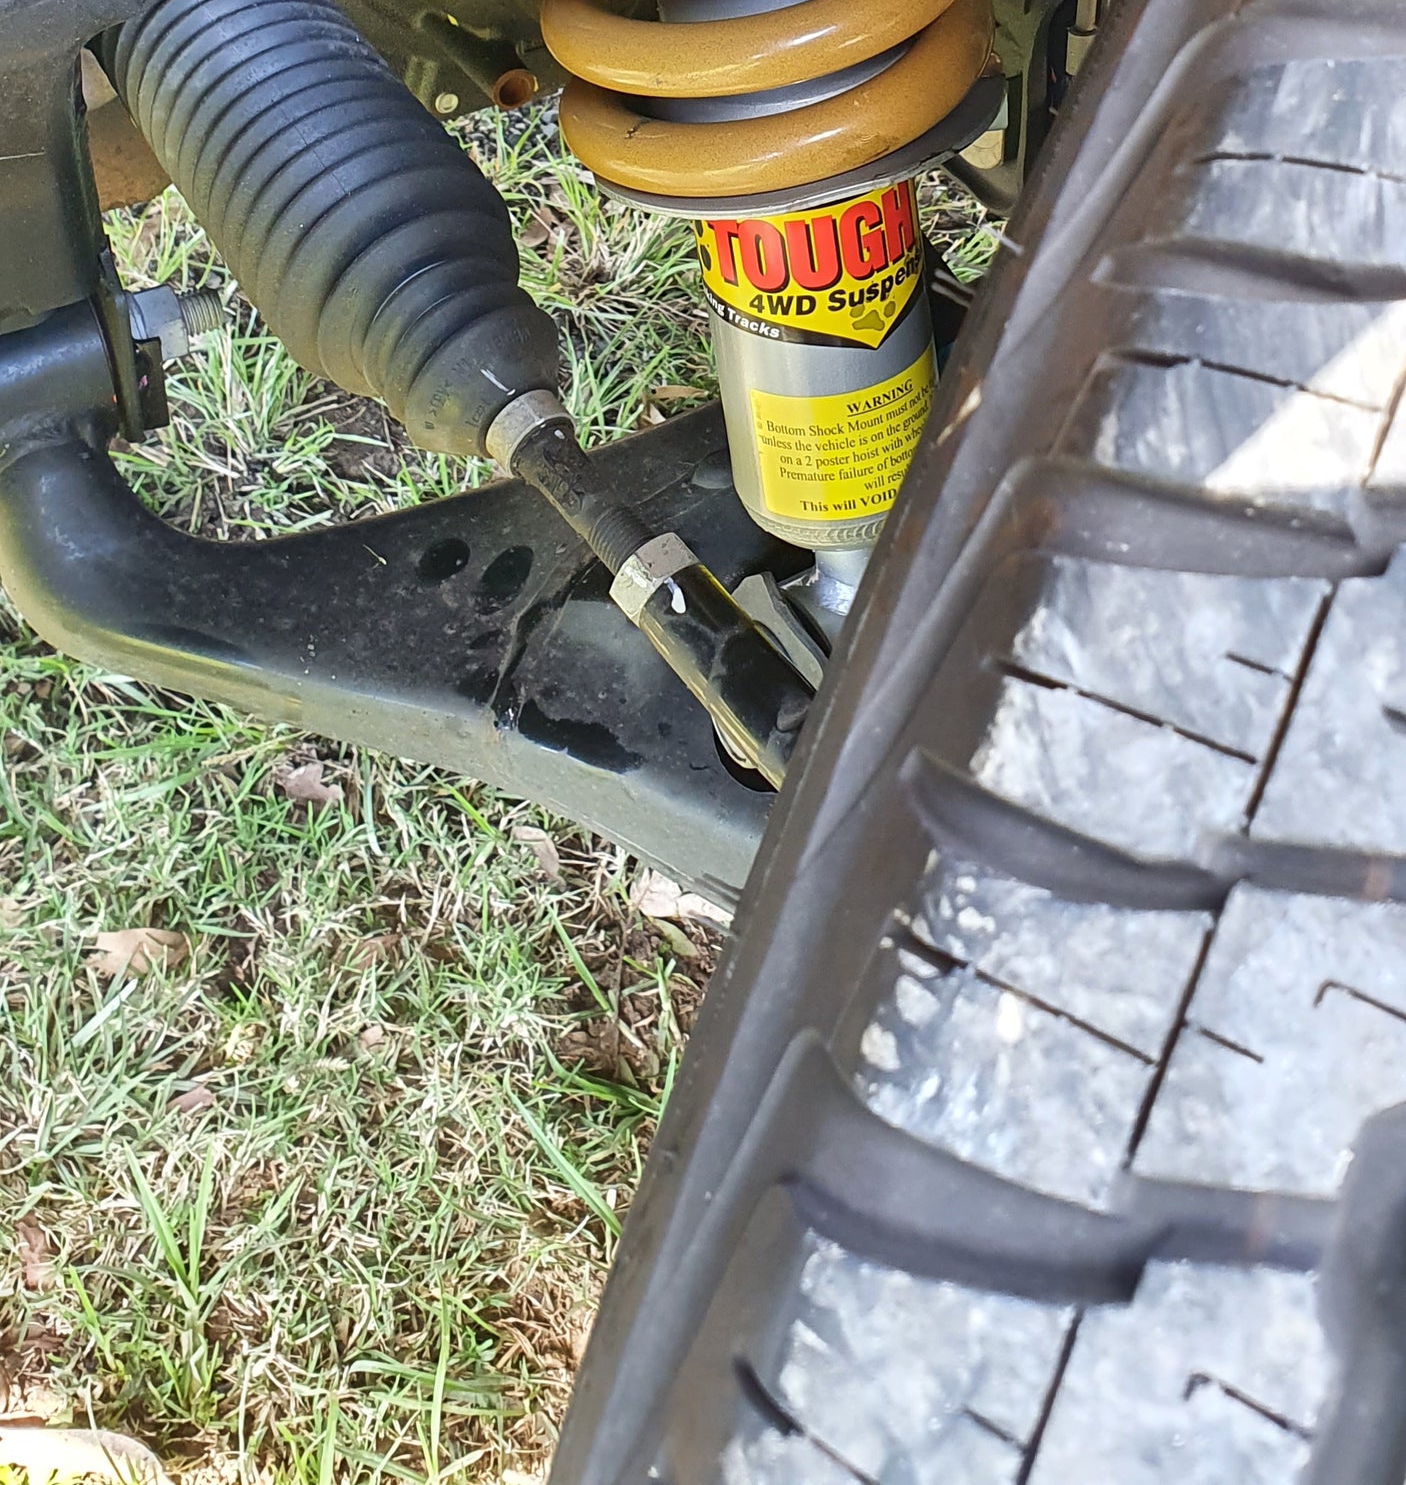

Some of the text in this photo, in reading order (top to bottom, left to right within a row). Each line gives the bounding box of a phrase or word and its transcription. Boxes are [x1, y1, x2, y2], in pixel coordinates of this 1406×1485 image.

[707, 180, 914, 293] TOUGH
[749, 294, 817, 316] 4WD
[727, 307, 780, 338] Tracks
[847, 379, 914, 414] WARNING
[766, 420, 806, 436] Bottom
[808, 423, 845, 437] Shock
[847, 415, 884, 433] Mount
[886, 403, 908, 421] must
[909, 391, 921, 408] not
[761, 434, 792, 450] unless
[795, 439, 812, 451] the
[815, 437, 856, 451] vehicle
[859, 434, 868, 446] is
[871, 431, 884, 443] on
[886, 423, 900, 437] the
[780, 455, 793, 465] on
[796, 457, 802, 466] a
[805, 455, 812, 467] 2
[815, 455, 850, 469] poster
[852, 446, 879, 463] hoist
[882, 436, 903, 454] with
[780, 447, 916, 482] Premature failure of botto
[864, 475, 885, 491] will
[800, 488, 897, 512] This will VOID
